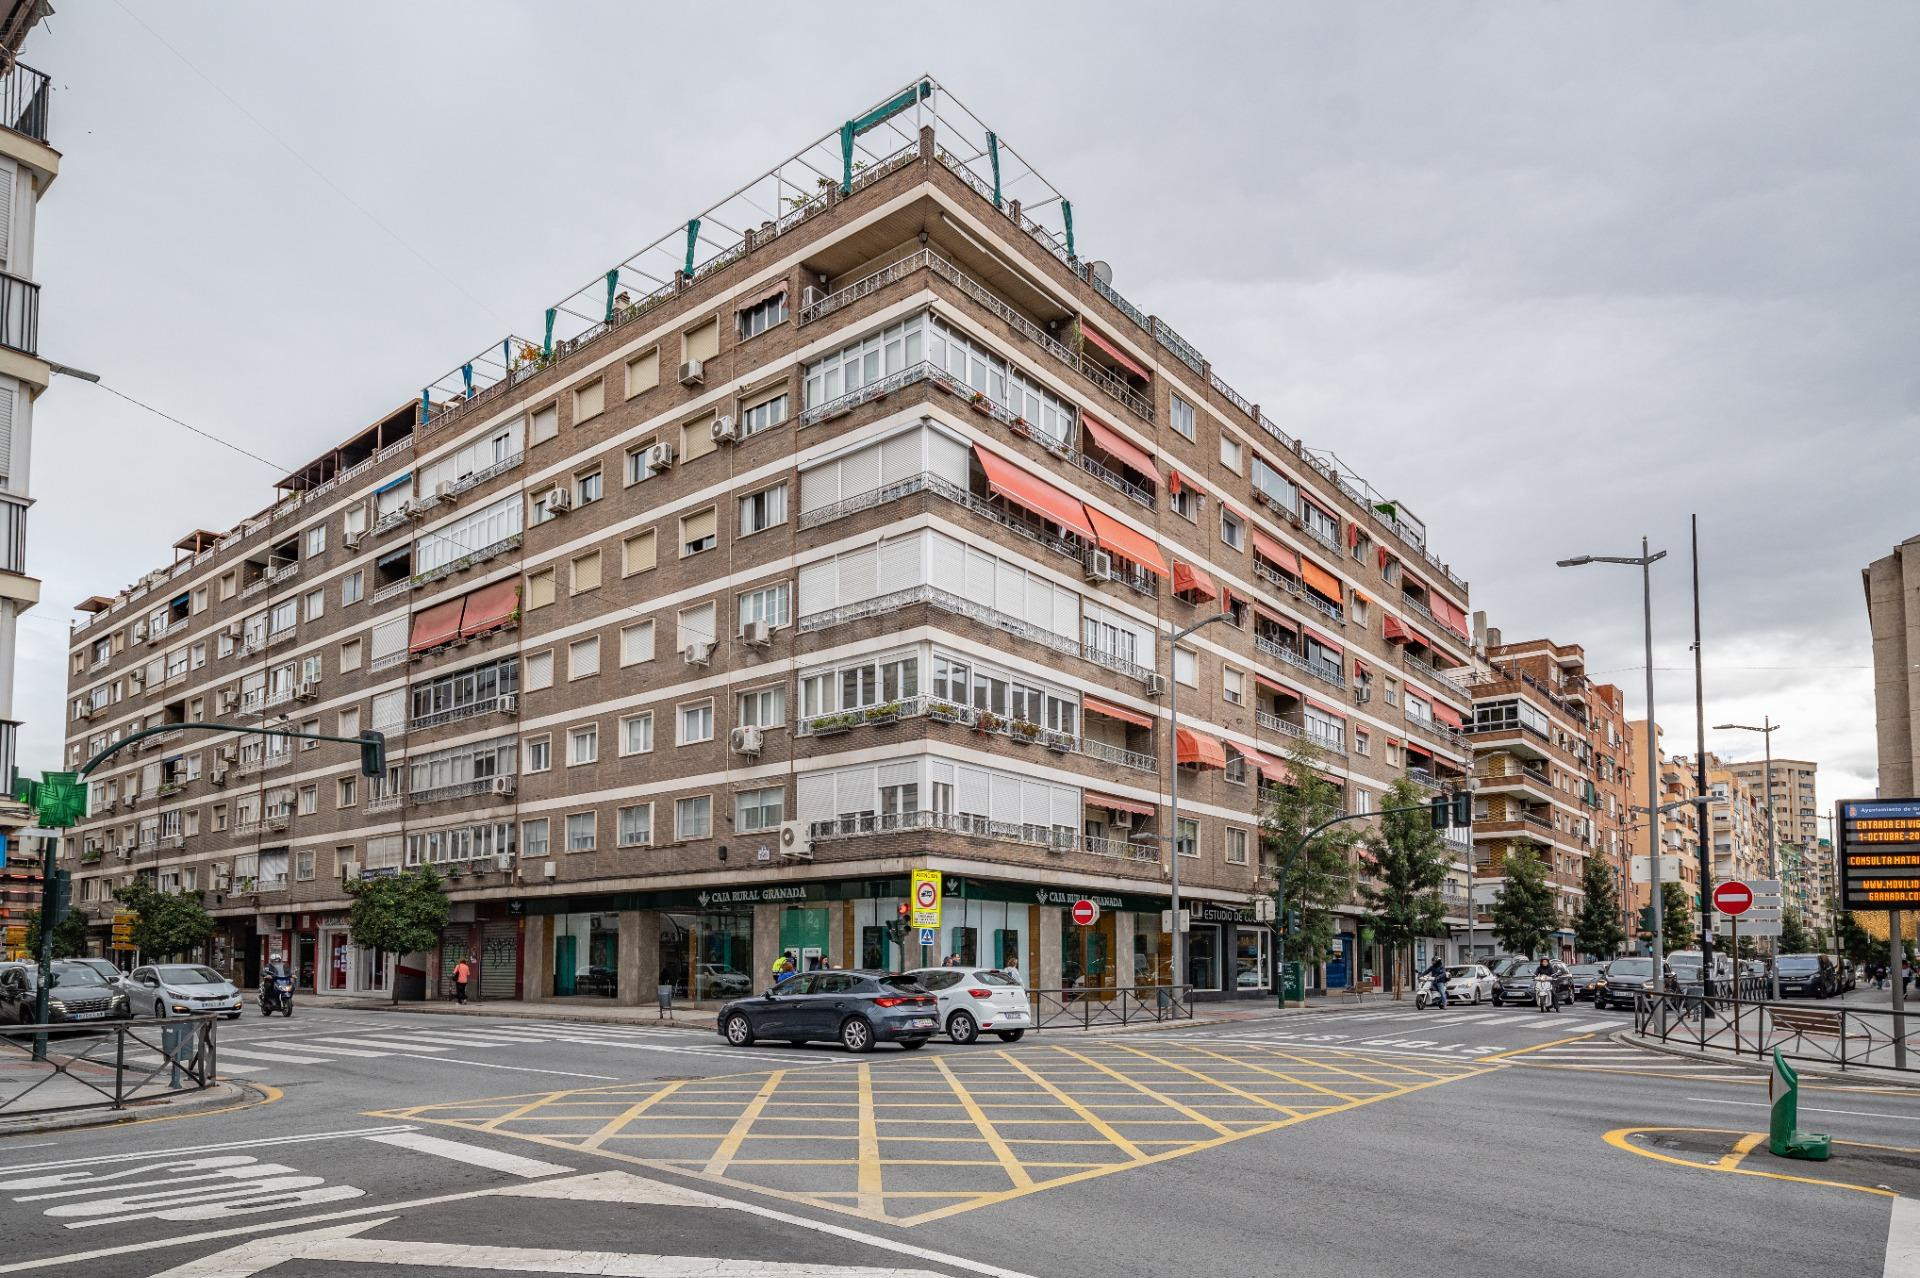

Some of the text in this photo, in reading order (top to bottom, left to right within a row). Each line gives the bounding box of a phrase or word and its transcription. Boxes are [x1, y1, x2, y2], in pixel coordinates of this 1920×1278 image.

[1856, 819, 1920, 829] ENTRADA EN VIG
[1859, 831, 1920, 841] 1-OCTUBRE-20
[1850, 856, 1893, 866] CONSULTA
[1863, 880, 1919, 889] WWW.MOVILID
[712, 886, 806, 902] CAJA RURAL GRANADA
[1049, 892, 1066, 903] CAJA
[1868, 891, 1920, 901] GRANADA.CO
[1204, 909, 1233, 921] ESTUDIO
[1234, 911, 1242, 922] DE
[1360, 1039, 1507, 1054] STOP
[0, 1155, 367, 1230] STOP
